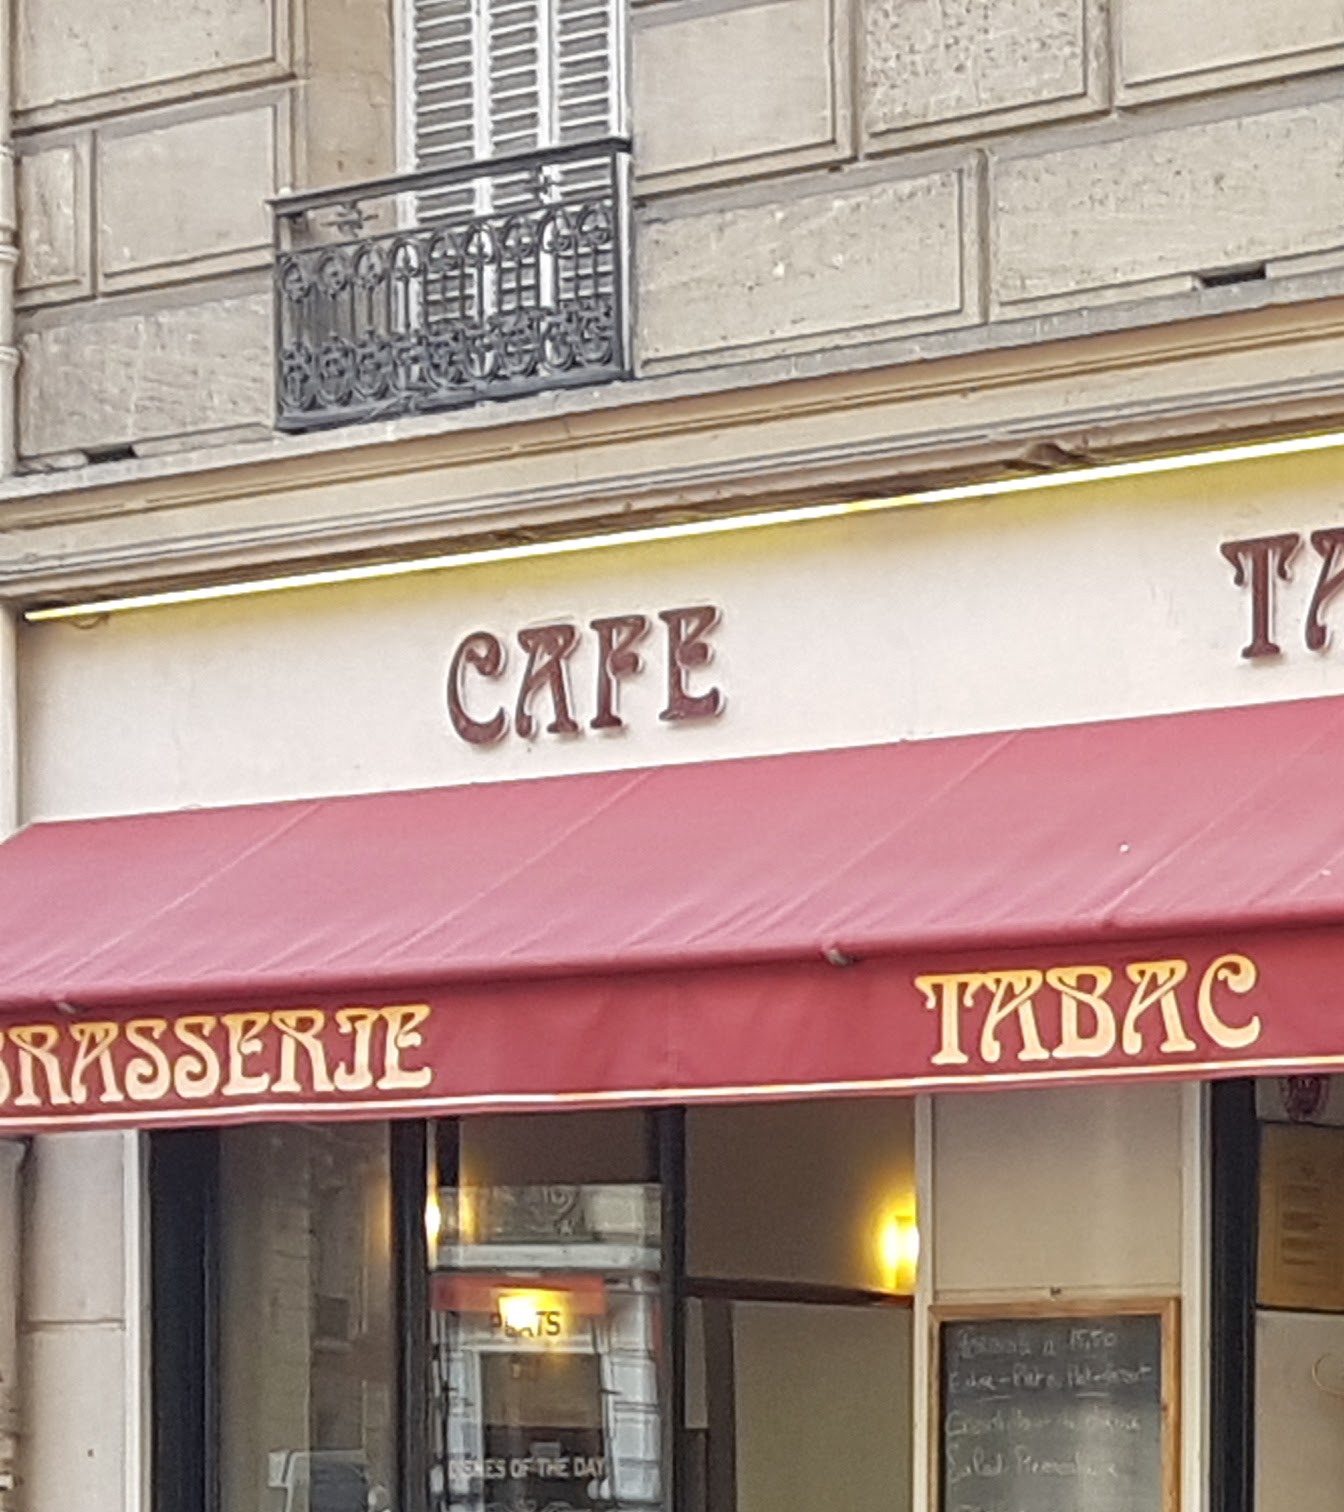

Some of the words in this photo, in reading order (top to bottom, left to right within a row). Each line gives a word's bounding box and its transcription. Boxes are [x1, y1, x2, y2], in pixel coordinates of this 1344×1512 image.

[447, 604, 722, 744] CAFE
[0, 1003, 433, 1107] RASSERIE
[914, 953, 1262, 1065] TABAC
[510, 1457, 533, 1480] OF
[537, 1457, 570, 1480] THE
[573, 1457, 606, 1479] DAY
